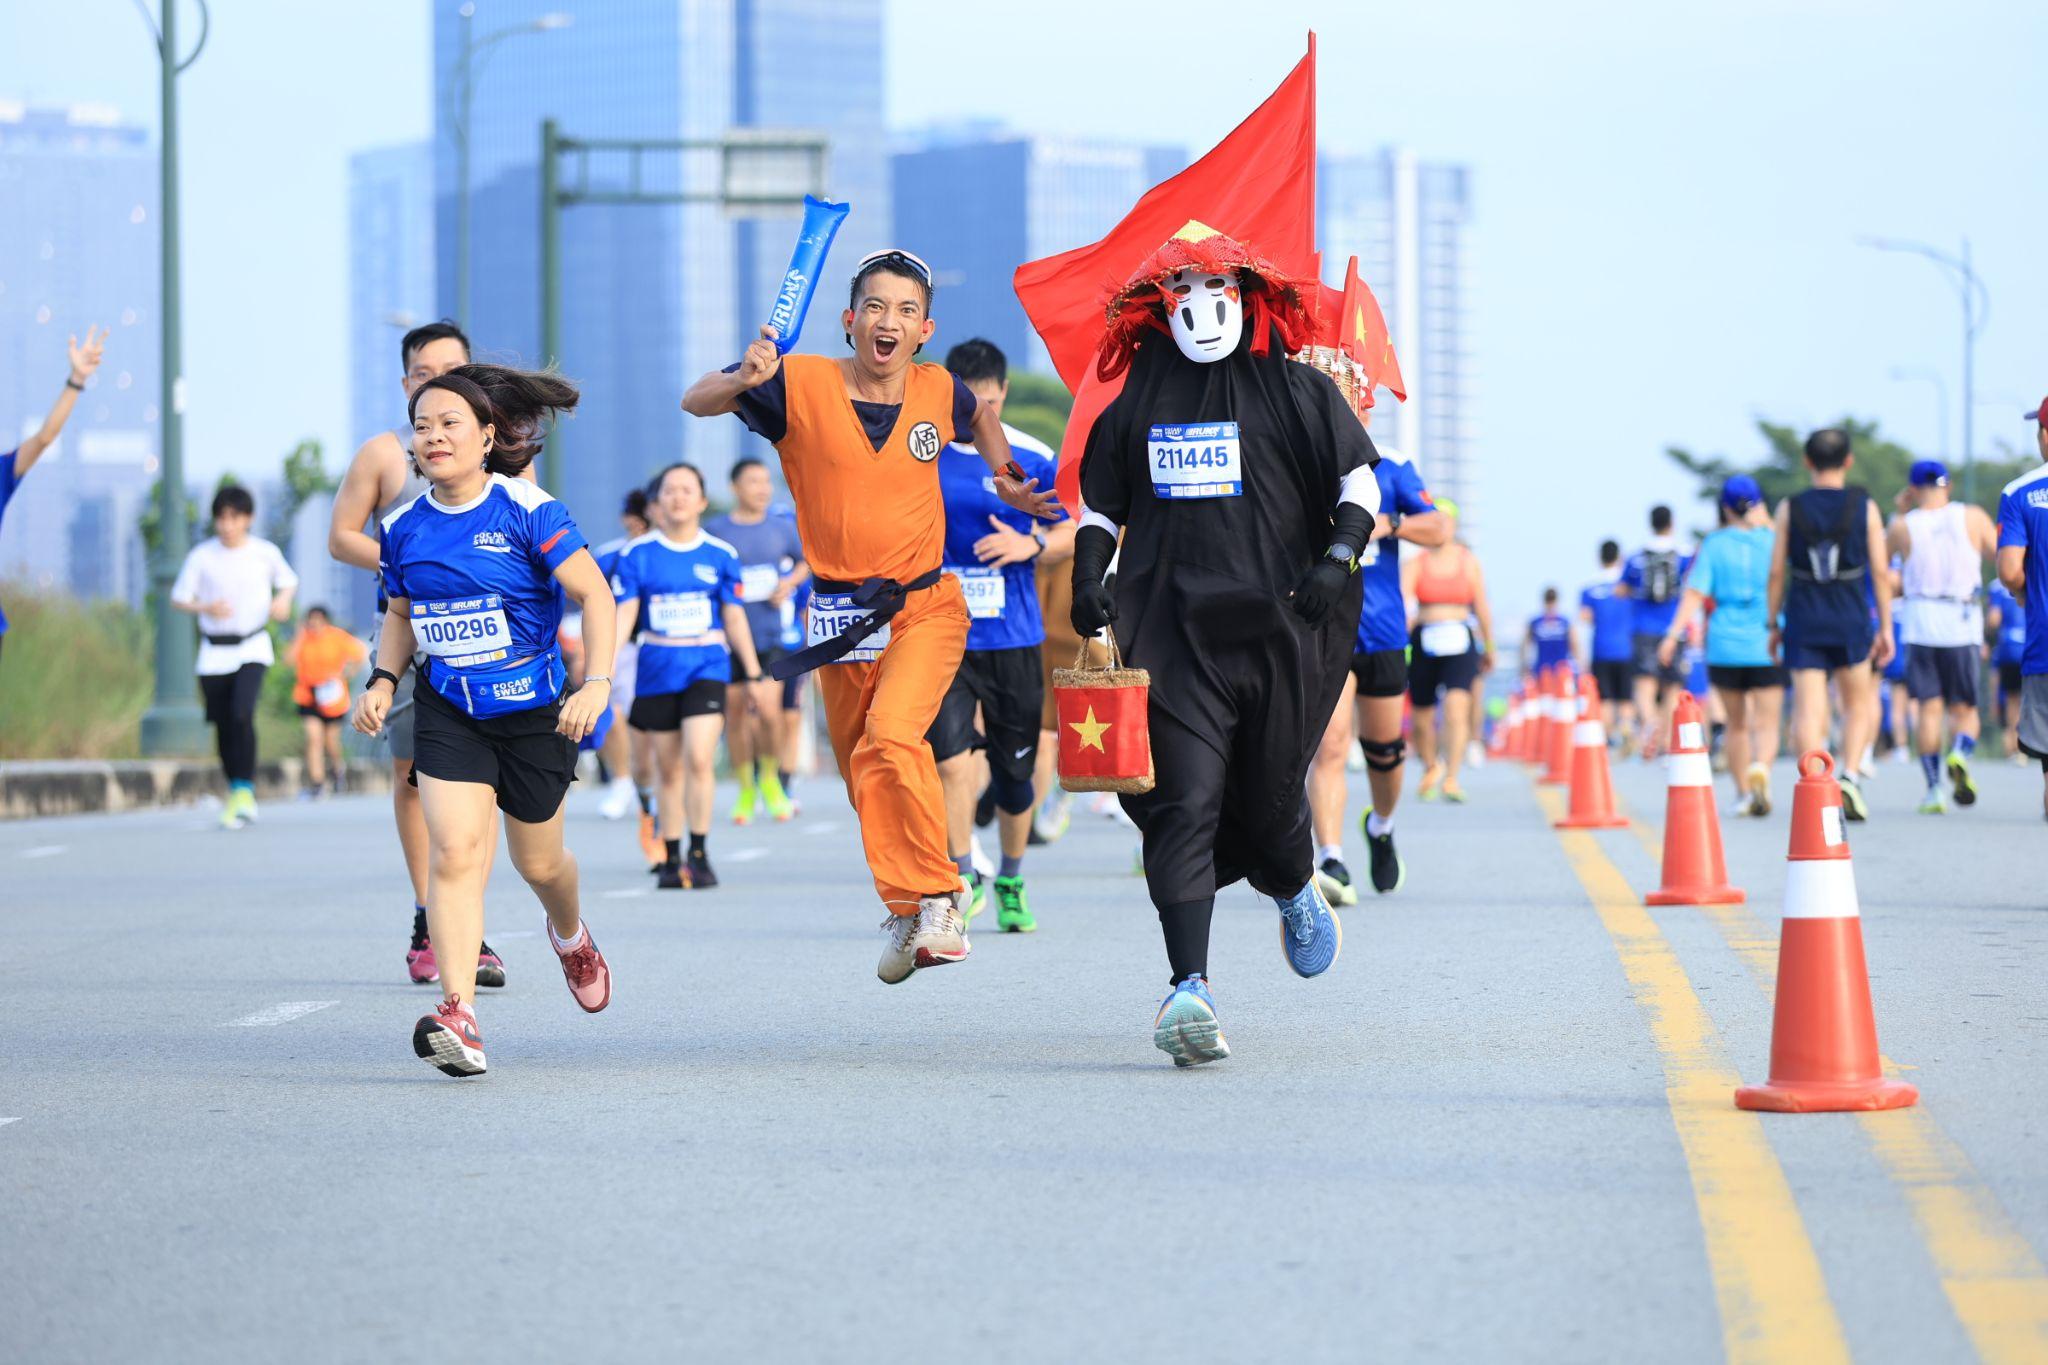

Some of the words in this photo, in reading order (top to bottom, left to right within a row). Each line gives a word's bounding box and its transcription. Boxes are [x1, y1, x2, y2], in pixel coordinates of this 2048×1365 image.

[914, 426, 936, 458] 悟
[1157, 445, 1228, 469] 211445
[961, 581, 996, 597] 597
[421, 616, 499, 643] 100296
[493, 676, 531, 690] POCARI
[494, 686, 529, 697] SWEAT
